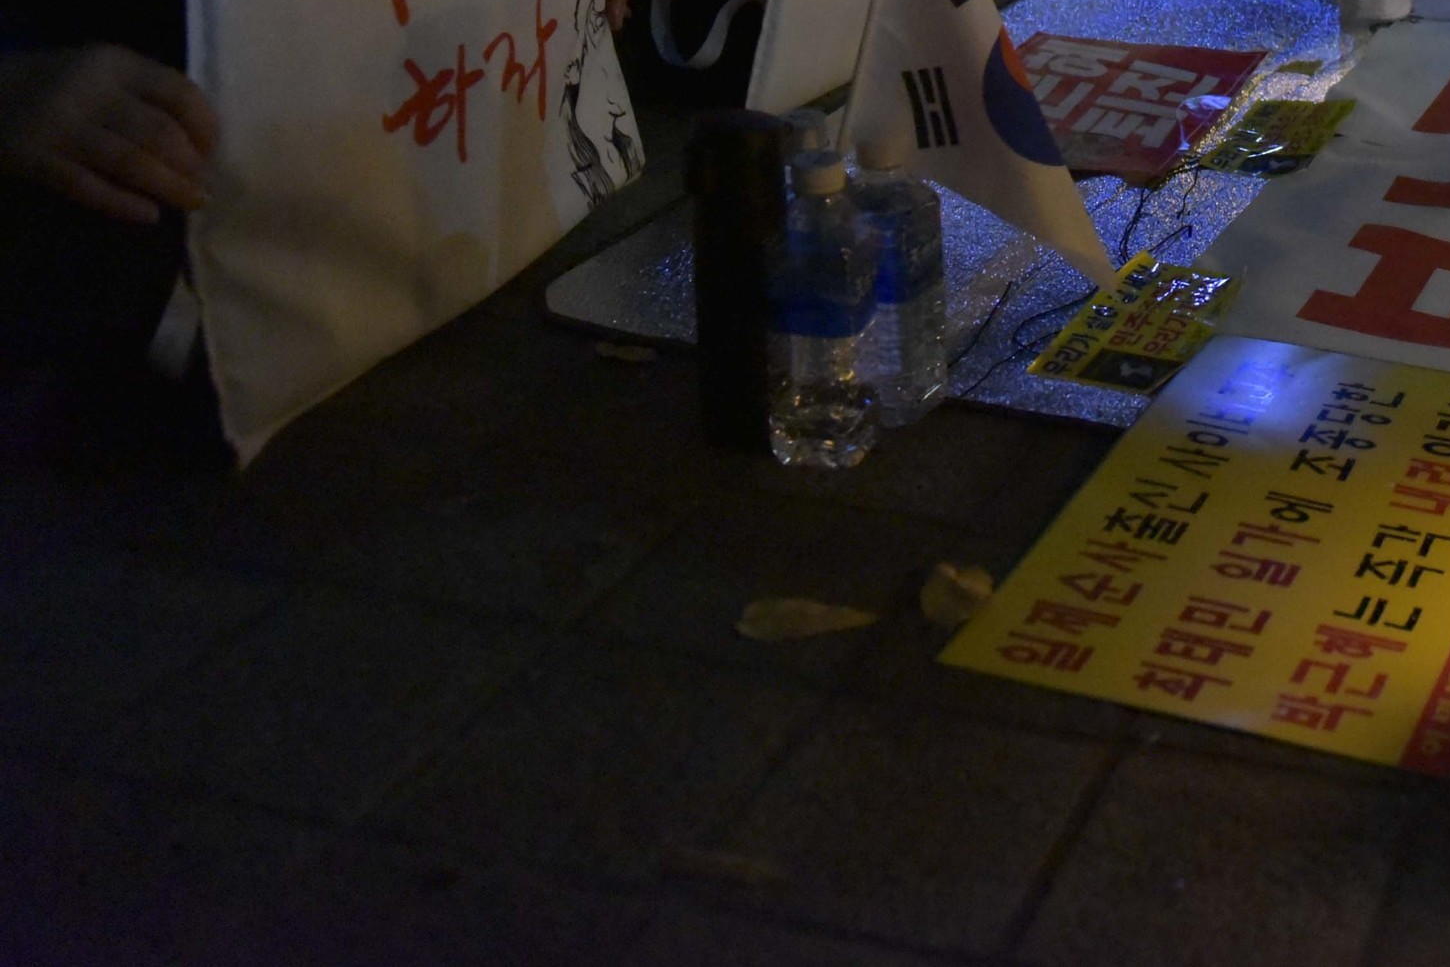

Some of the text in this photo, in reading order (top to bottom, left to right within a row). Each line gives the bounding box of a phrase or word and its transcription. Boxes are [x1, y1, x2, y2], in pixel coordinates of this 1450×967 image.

[998, 479, 1211, 672] 일제순사출신
[1135, 382, 1406, 702] 최태민 일가에 조종당한
[1269, 592, 1422, 732] 박근혜는
